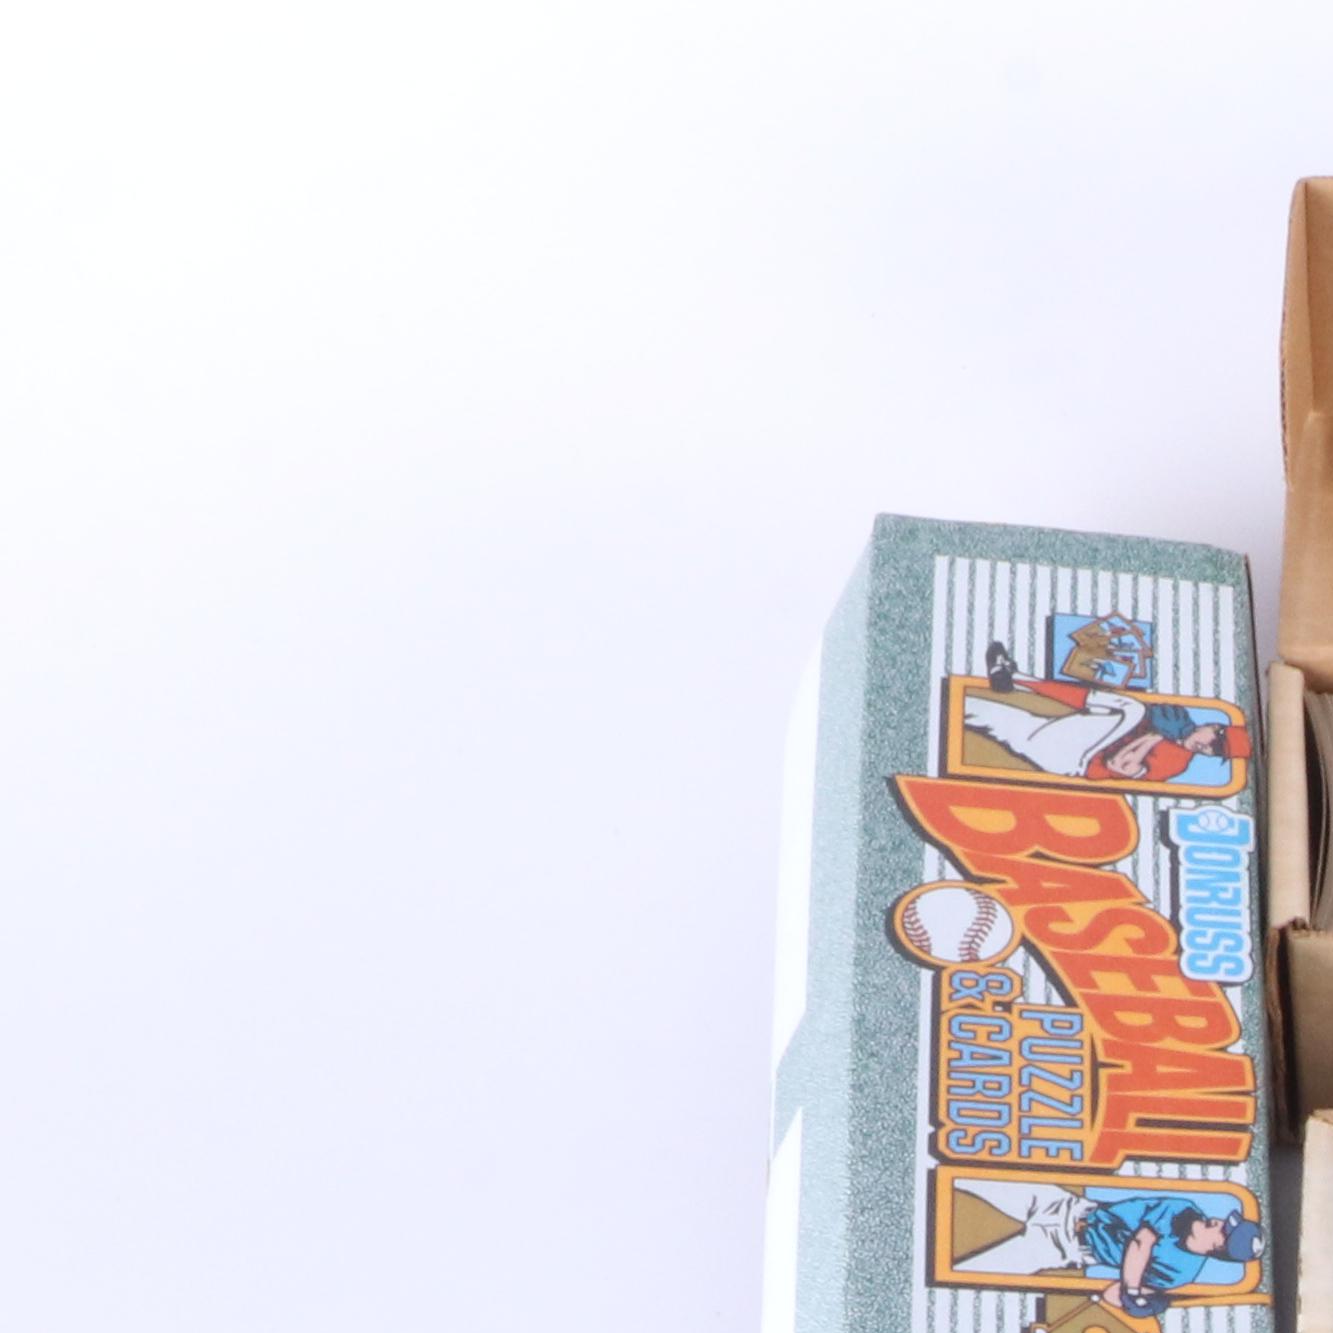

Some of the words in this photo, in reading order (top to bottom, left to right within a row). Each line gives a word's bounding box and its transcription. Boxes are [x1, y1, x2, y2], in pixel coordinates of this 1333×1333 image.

[894, 774, 1255, 1164] BASEBALL
[1172, 807, 1253, 980] DONRUSS
[948, 969, 1012, 1004] &
[944, 1012, 1013, 1156] CARDS
[1019, 1005, 1085, 1162] PUZZLE
